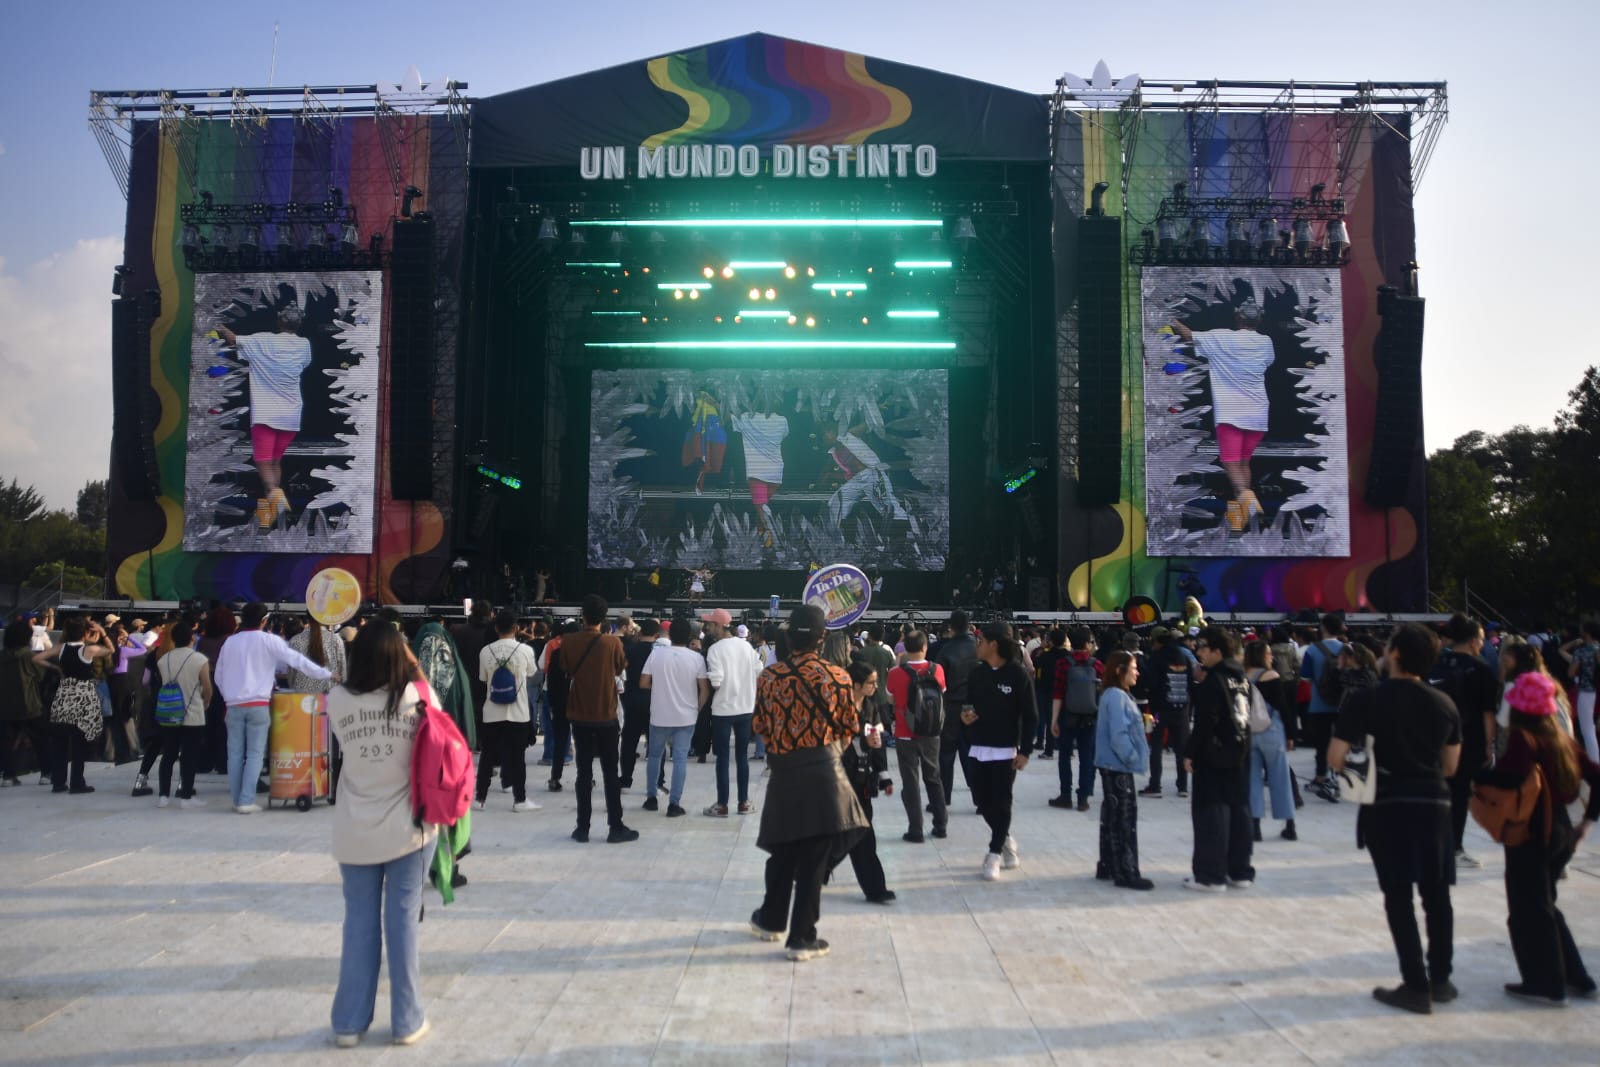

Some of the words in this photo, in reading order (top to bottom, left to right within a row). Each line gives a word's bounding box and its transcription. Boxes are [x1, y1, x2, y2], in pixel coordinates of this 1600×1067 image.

[580, 146, 625, 179] UN
[637, 144, 760, 178] MUNDO
[772, 144, 937, 178] DISTINTO
